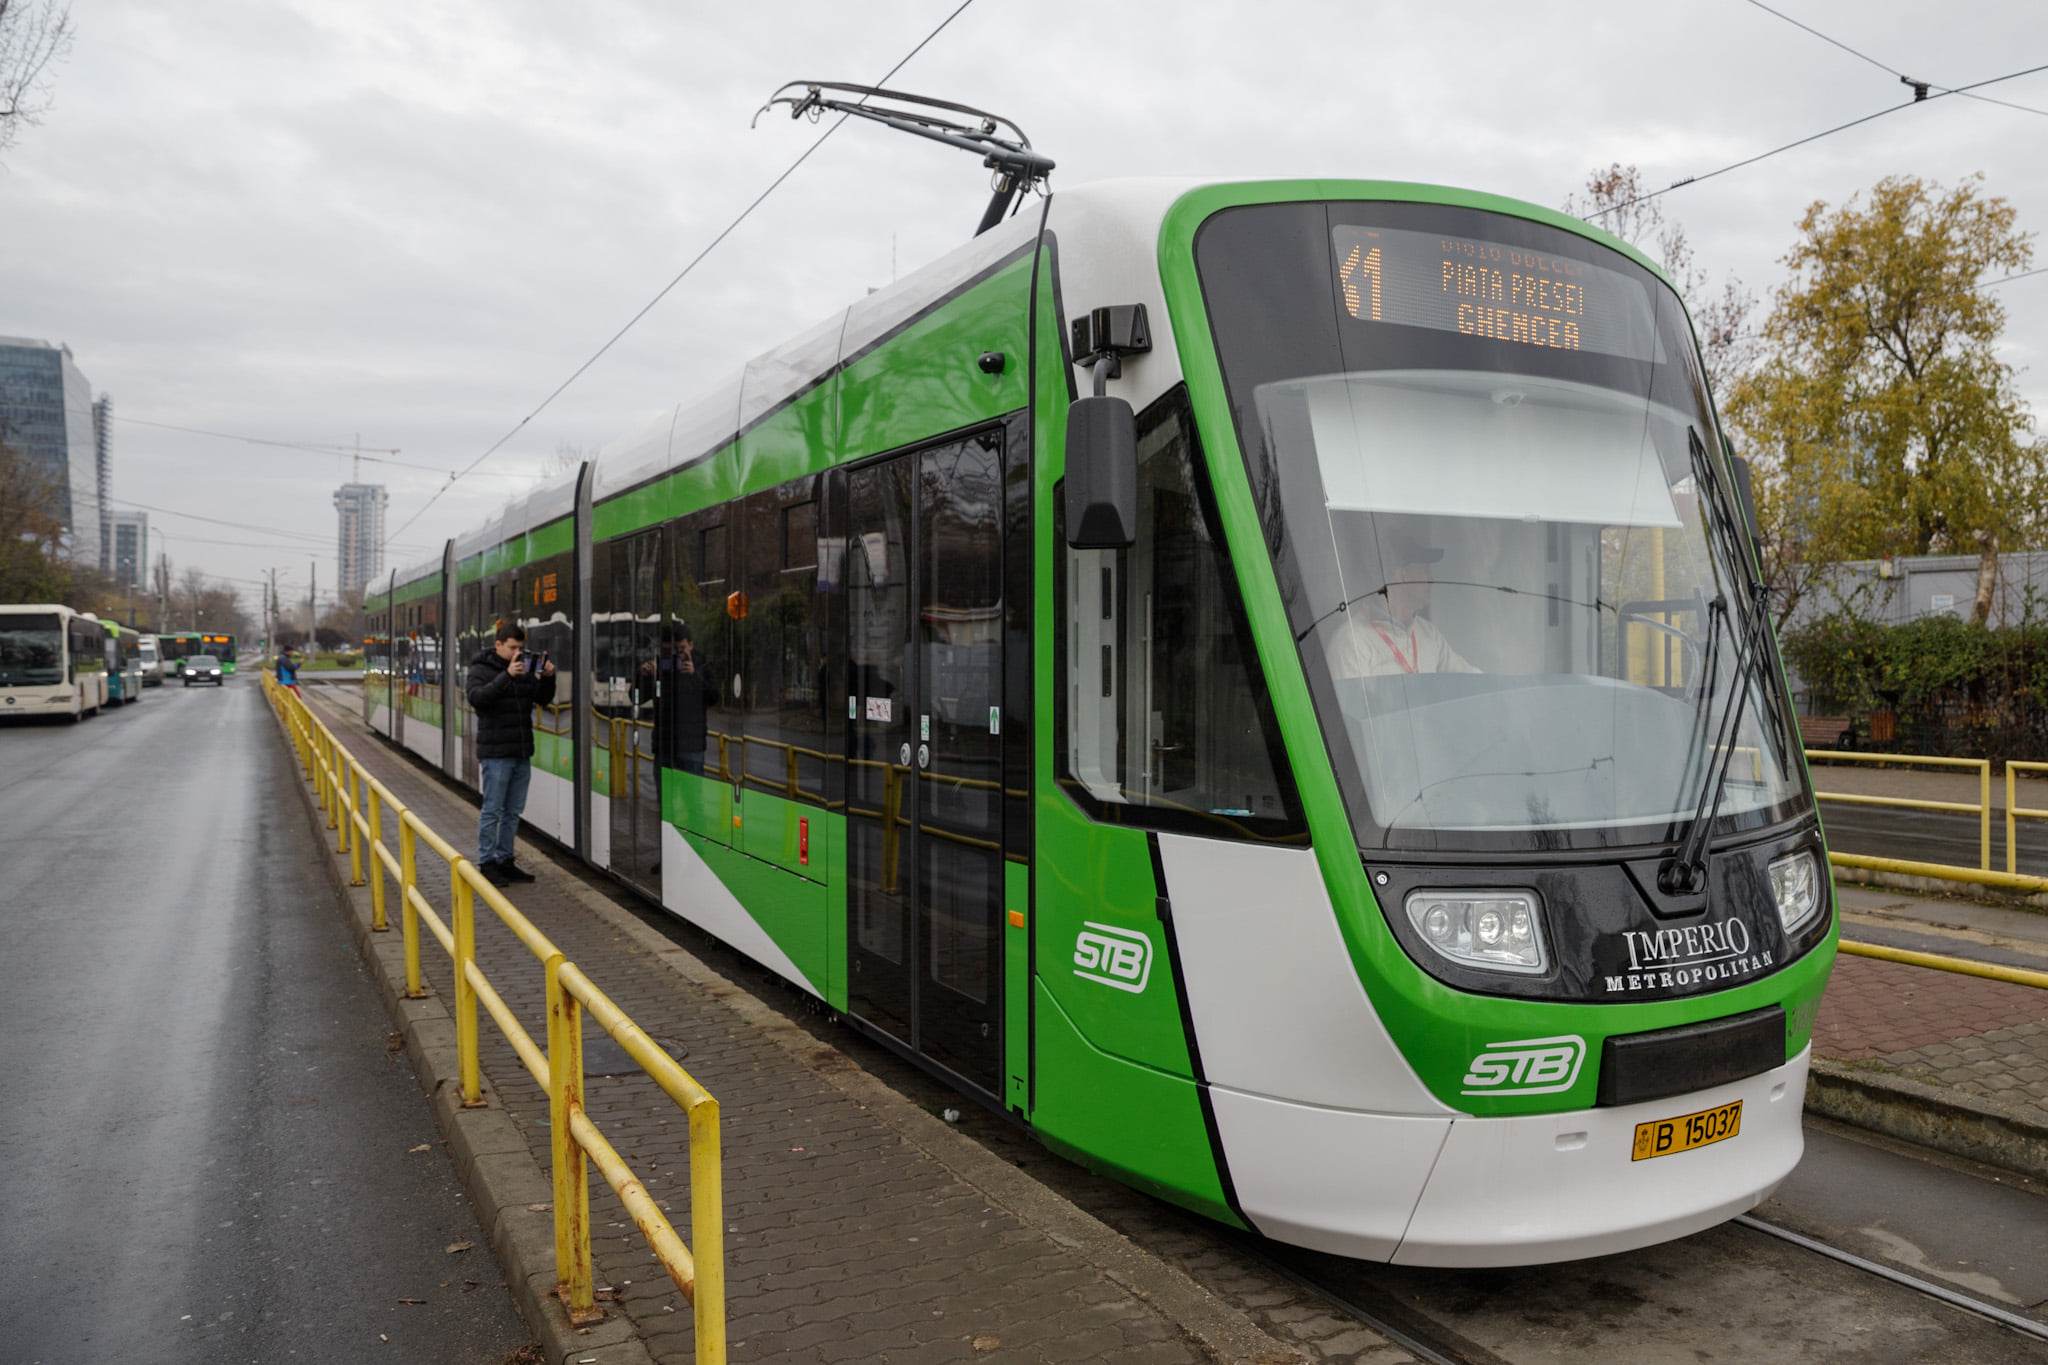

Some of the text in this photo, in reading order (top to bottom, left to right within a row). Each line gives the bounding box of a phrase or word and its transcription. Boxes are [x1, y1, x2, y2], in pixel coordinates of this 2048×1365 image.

[1340, 244, 1381, 320] 41
[1442, 260, 1503, 301] PIATA
[1511, 272, 1584, 316] PRESEI
[1457, 303, 1580, 350] GHENCEA
[1073, 931, 1144, 980] STB
[1622, 917, 1750, 971] IMPERIO
[1605, 950, 1774, 992] METROPOLITAN
[1462, 1046, 1575, 1086] STB
[1656, 1105, 1740, 1152] B 15037
